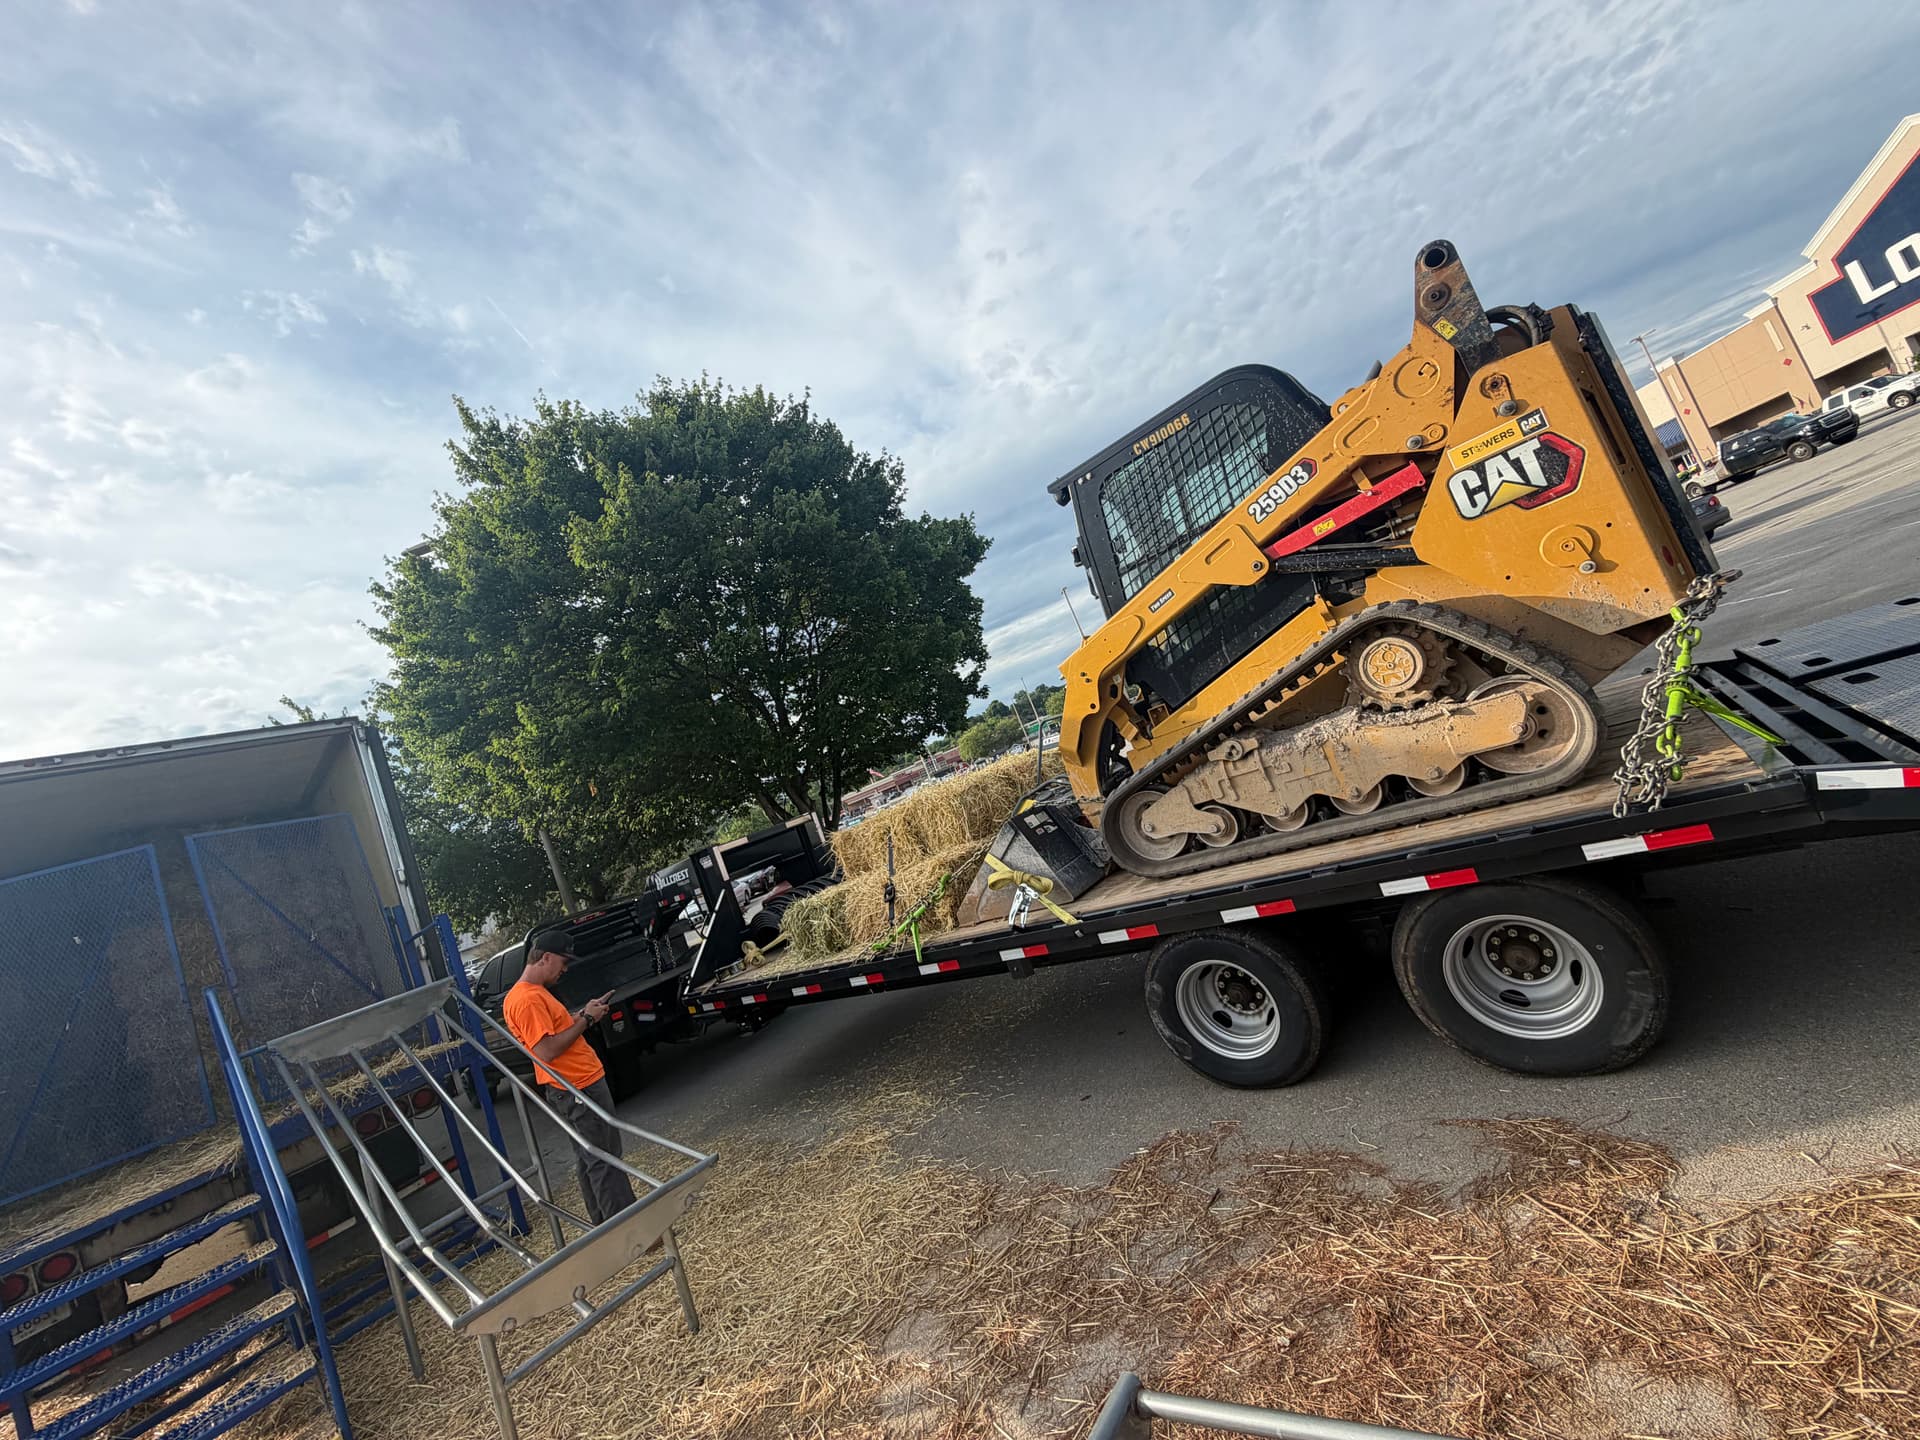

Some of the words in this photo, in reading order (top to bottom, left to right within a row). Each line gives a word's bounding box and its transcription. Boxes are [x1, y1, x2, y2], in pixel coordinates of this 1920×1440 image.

[1844, 232, 1920, 305] LO
[1133, 413, 1190, 456] CW910066
[1520, 414, 1542, 431] CAT
[1248, 465, 1309, 523] 259D3
[1448, 438, 1548, 518] CAT
